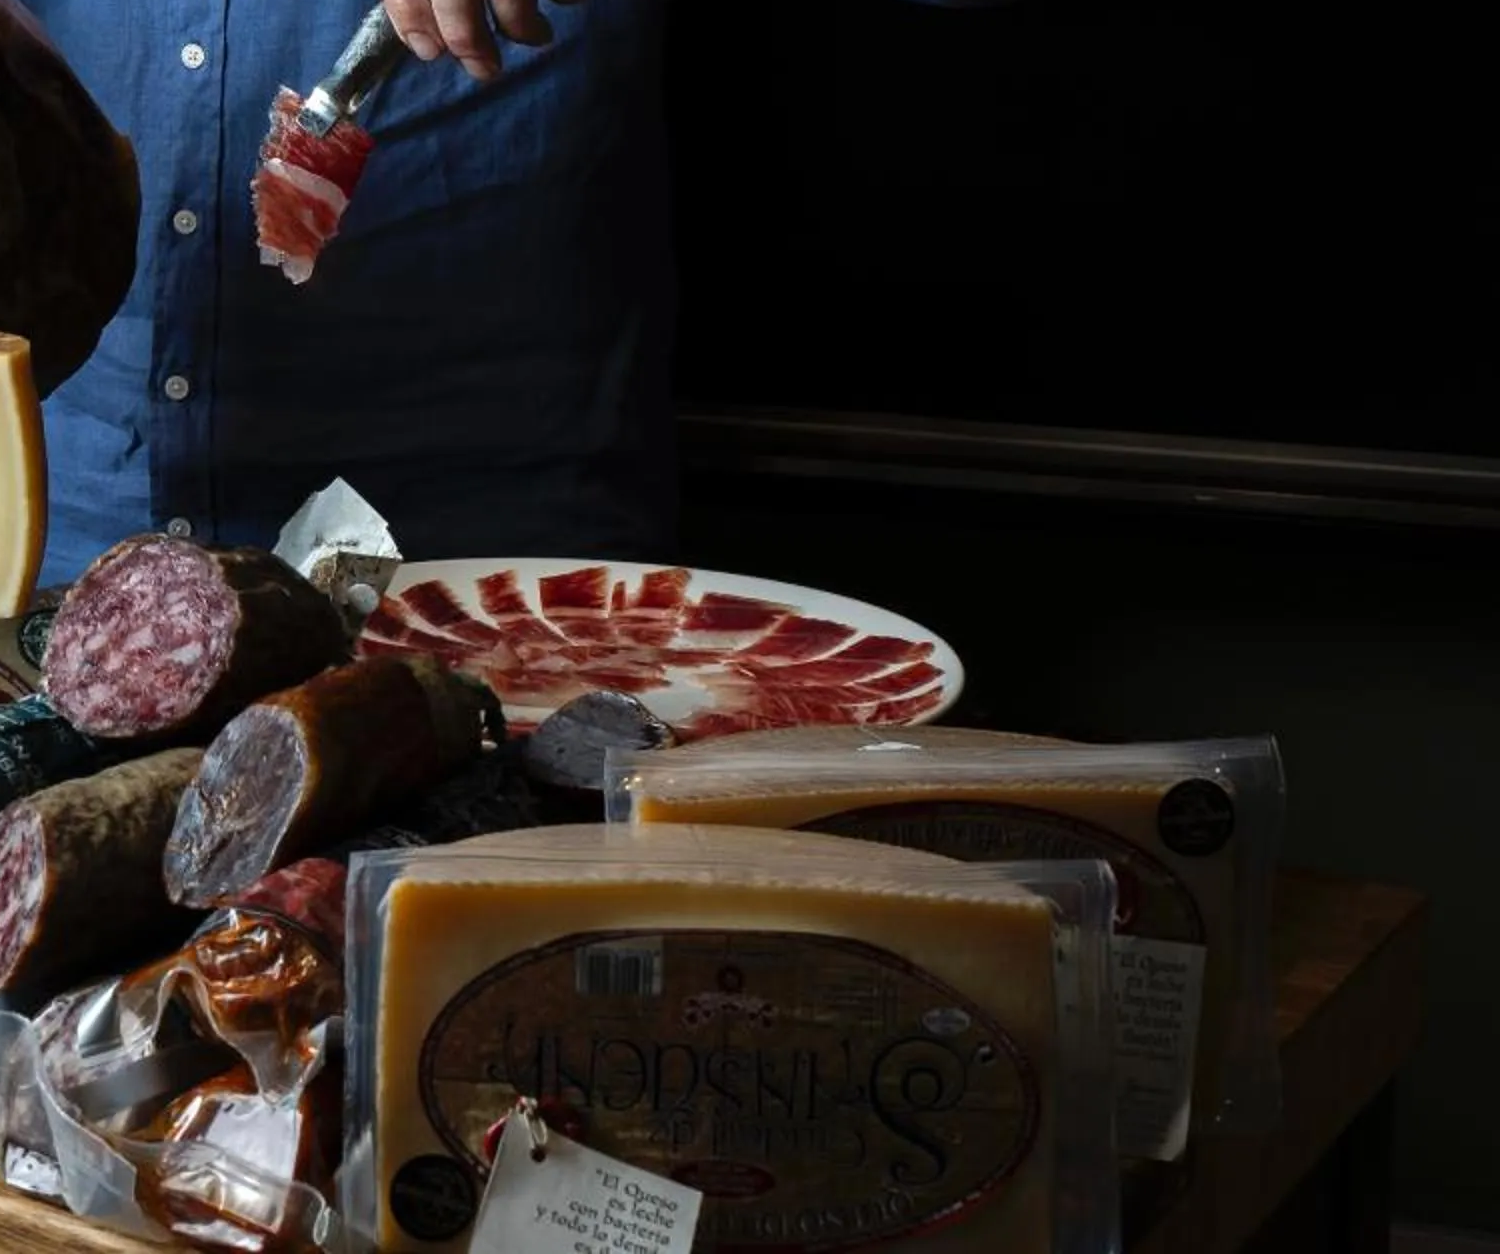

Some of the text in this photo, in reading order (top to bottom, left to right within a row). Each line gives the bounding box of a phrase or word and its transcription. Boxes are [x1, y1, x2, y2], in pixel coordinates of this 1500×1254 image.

[608, 1197, 627, 1213] es
[632, 1200, 676, 1229] leche
[624, 1182, 679, 1212] Queso
[534, 1203, 547, 1221] y
[550, 1209, 588, 1235] todo
[592, 1223, 609, 1242] lo
[569, 1199, 599, 1219] con
[602, 1208, 671, 1246] bacteria
